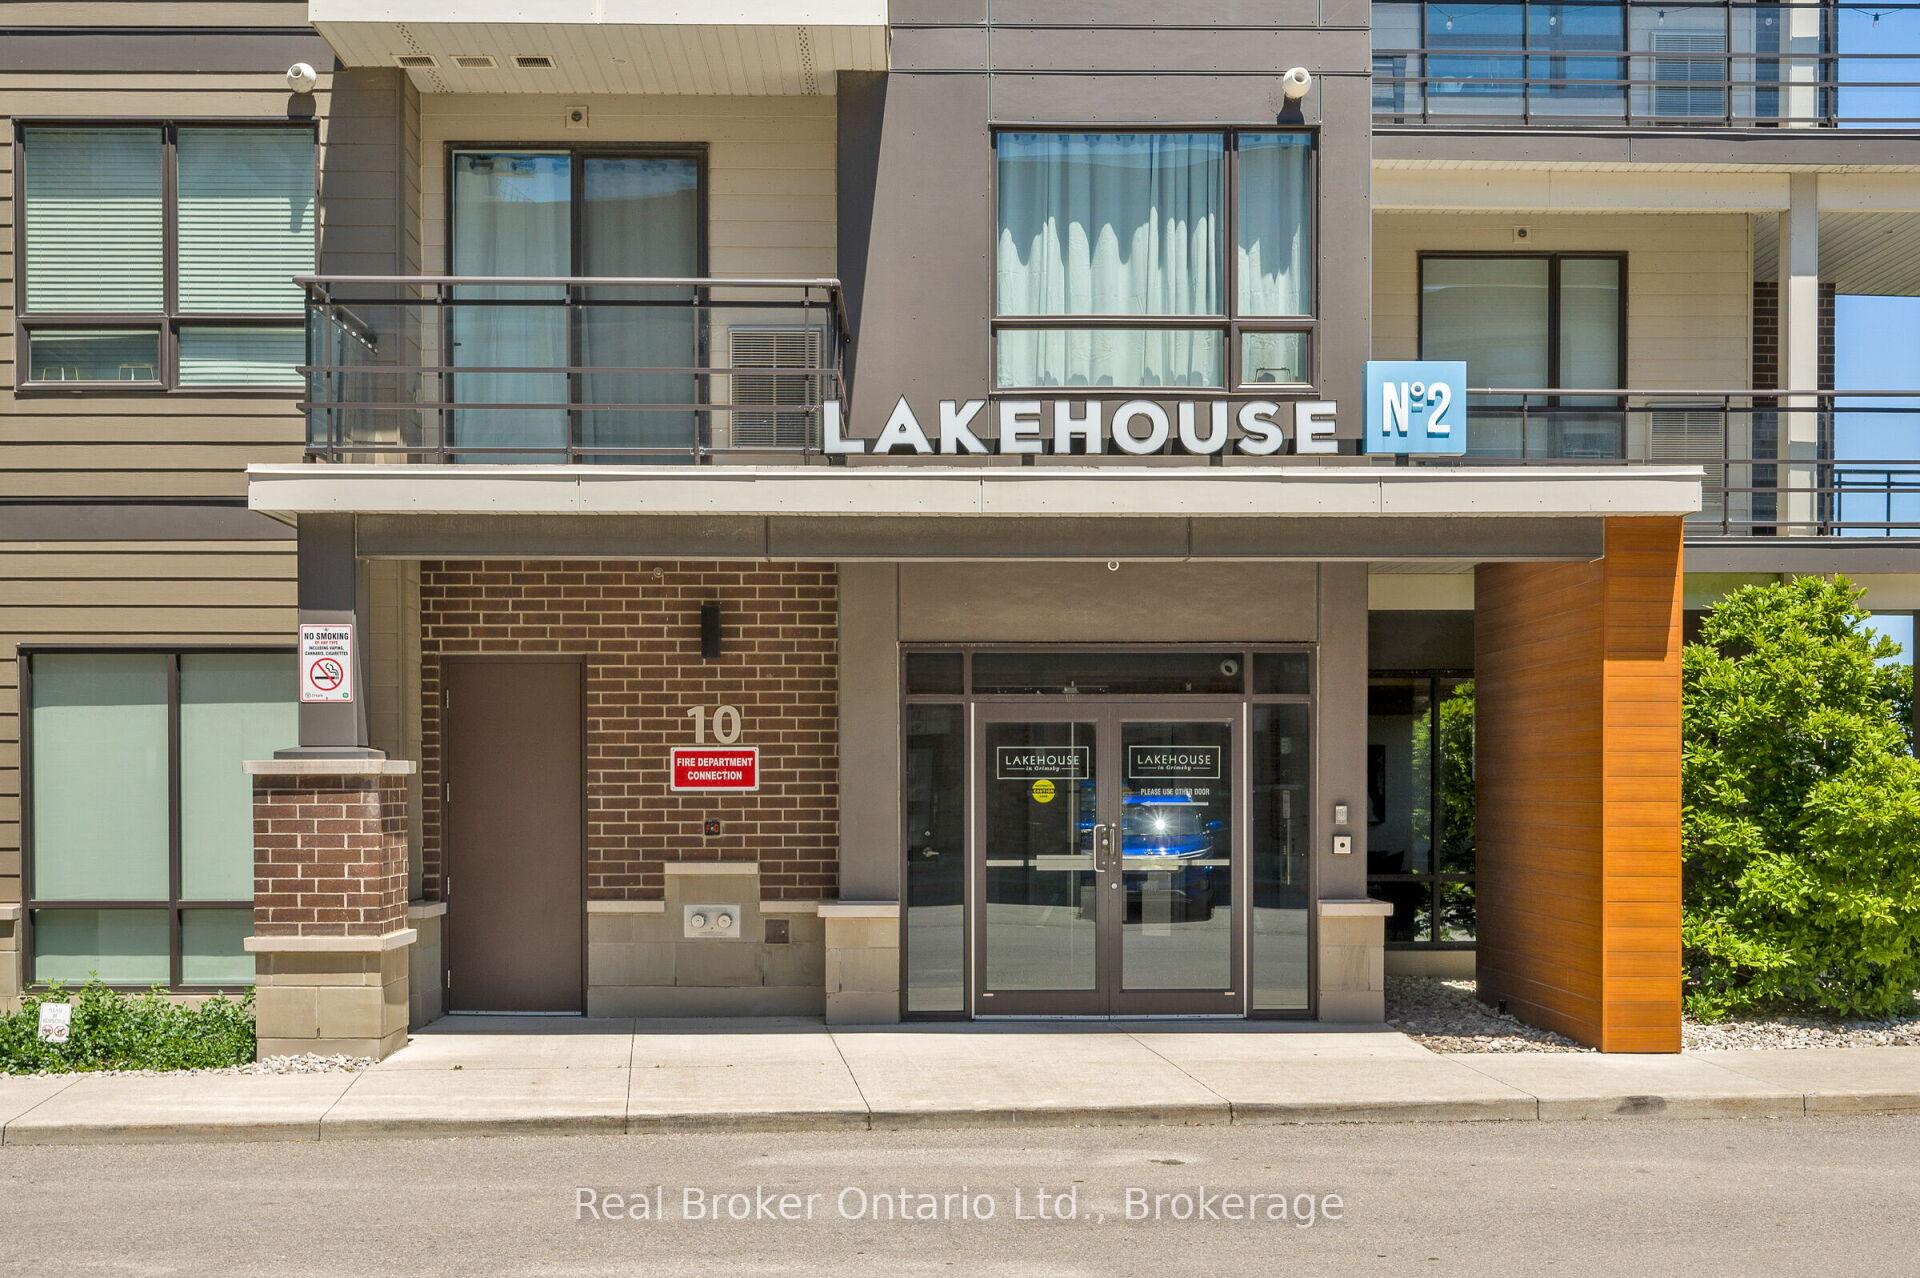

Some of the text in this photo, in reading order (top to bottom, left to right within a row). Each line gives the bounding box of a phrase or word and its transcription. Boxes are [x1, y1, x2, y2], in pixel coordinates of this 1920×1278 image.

[823, 394, 1338, 455] LAKEHOUSE
[304, 632, 349, 640] NO SMOKING
[687, 705, 741, 744] 10
[677, 757, 753, 767] FIRE DEPARTMENT
[1005, 755, 1080, 765] LAKEHOUSE
[1137, 754, 1211, 765] LAKEHOUSE
[687, 771, 742, 780] CONNECTION
[1140, 788, 1161, 796] PLEASE
[1163, 788, 1174, 796] USE
[1194, 788, 1210, 796] DOOR
